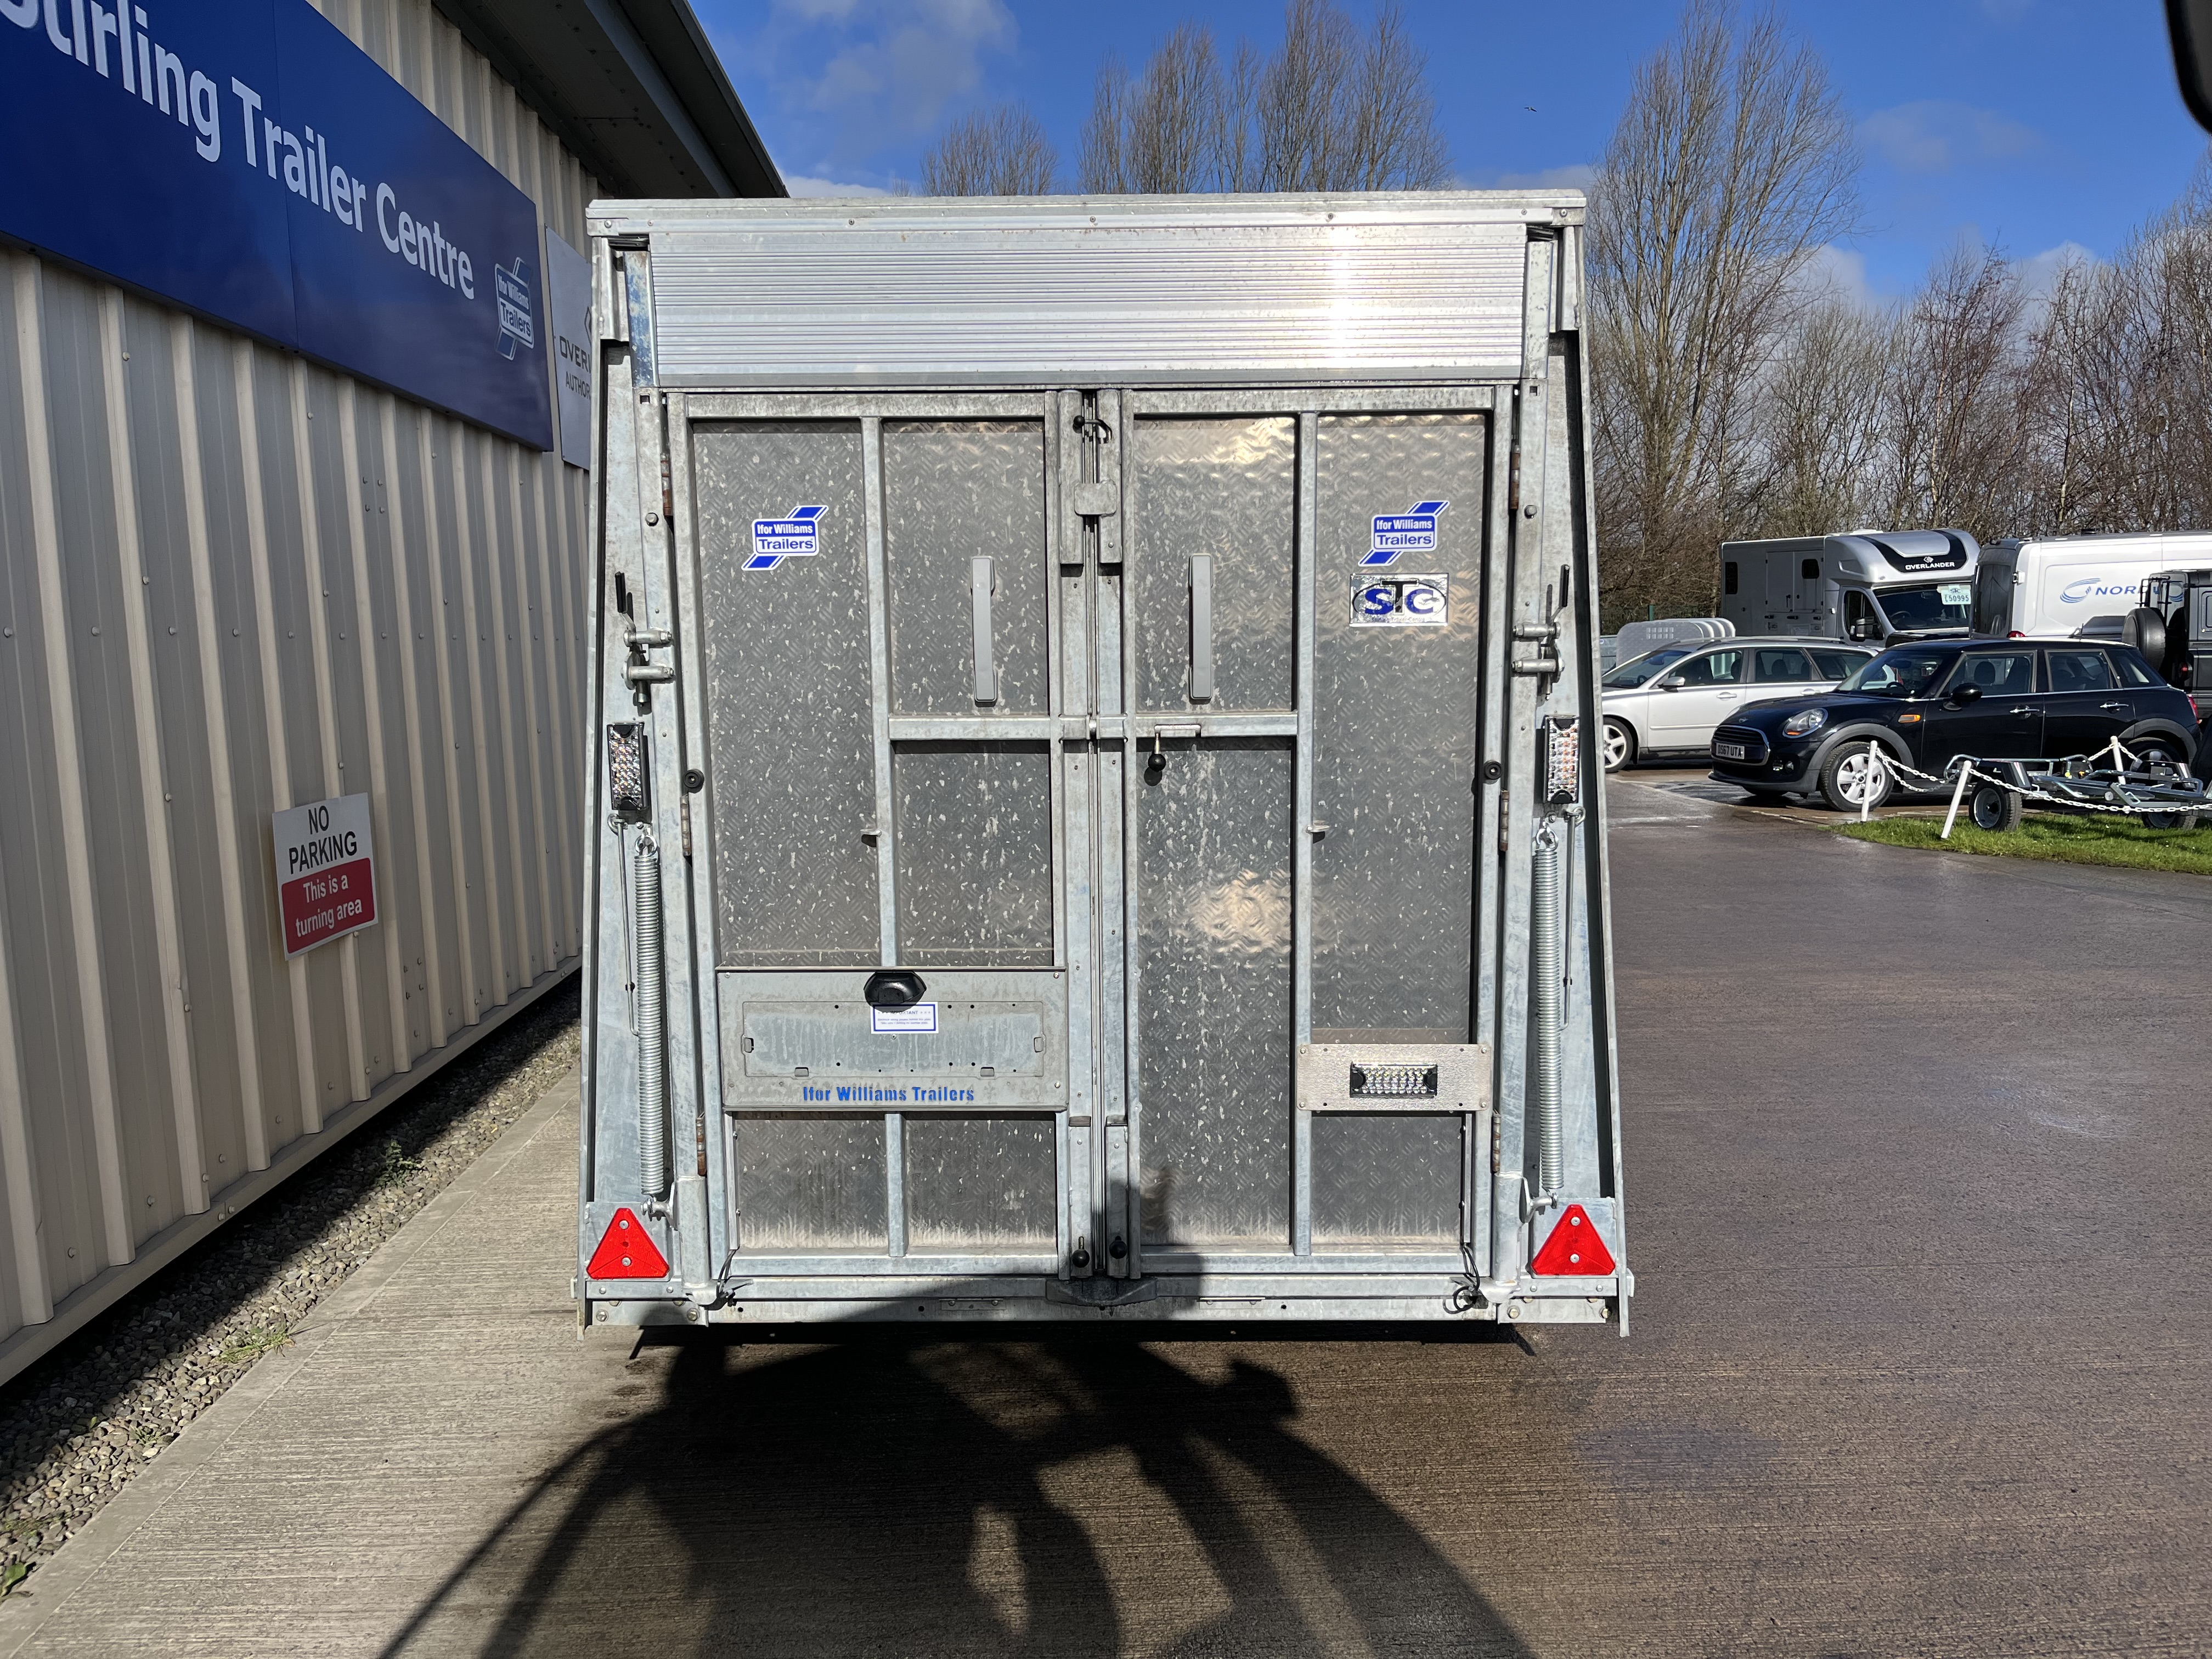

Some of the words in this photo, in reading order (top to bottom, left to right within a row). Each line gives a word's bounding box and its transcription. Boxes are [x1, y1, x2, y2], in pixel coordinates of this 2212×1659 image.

[231, 76, 366, 233] Trailer
[376, 182, 475, 300] Centre
[500, 301, 531, 337] Trailers
[757, 524, 772, 534] Ifor
[773, 523, 813, 534] Williams
[1376, 520, 1392, 530] Ifor
[1392, 518, 1432, 530] Williams
[758, 538, 814, 550] Trailers
[1376, 534, 1432, 545] Trailers
[1905, 562, 1955, 570] OVERLANDER
[1730, 746, 1742, 757] UTA
[308, 805, 329, 834] NO
[289, 831, 357, 874] PARKING
[303, 879, 326, 903] This
[328, 874, 338, 895] is
[341, 874, 349, 890] a
[295, 908, 334, 938] turning
[336, 898, 363, 921] area
[803, 1086, 831, 1101] Ifor
[836, 1086, 907, 1101] Williams
[912, 1086, 974, 1101] Trailers
